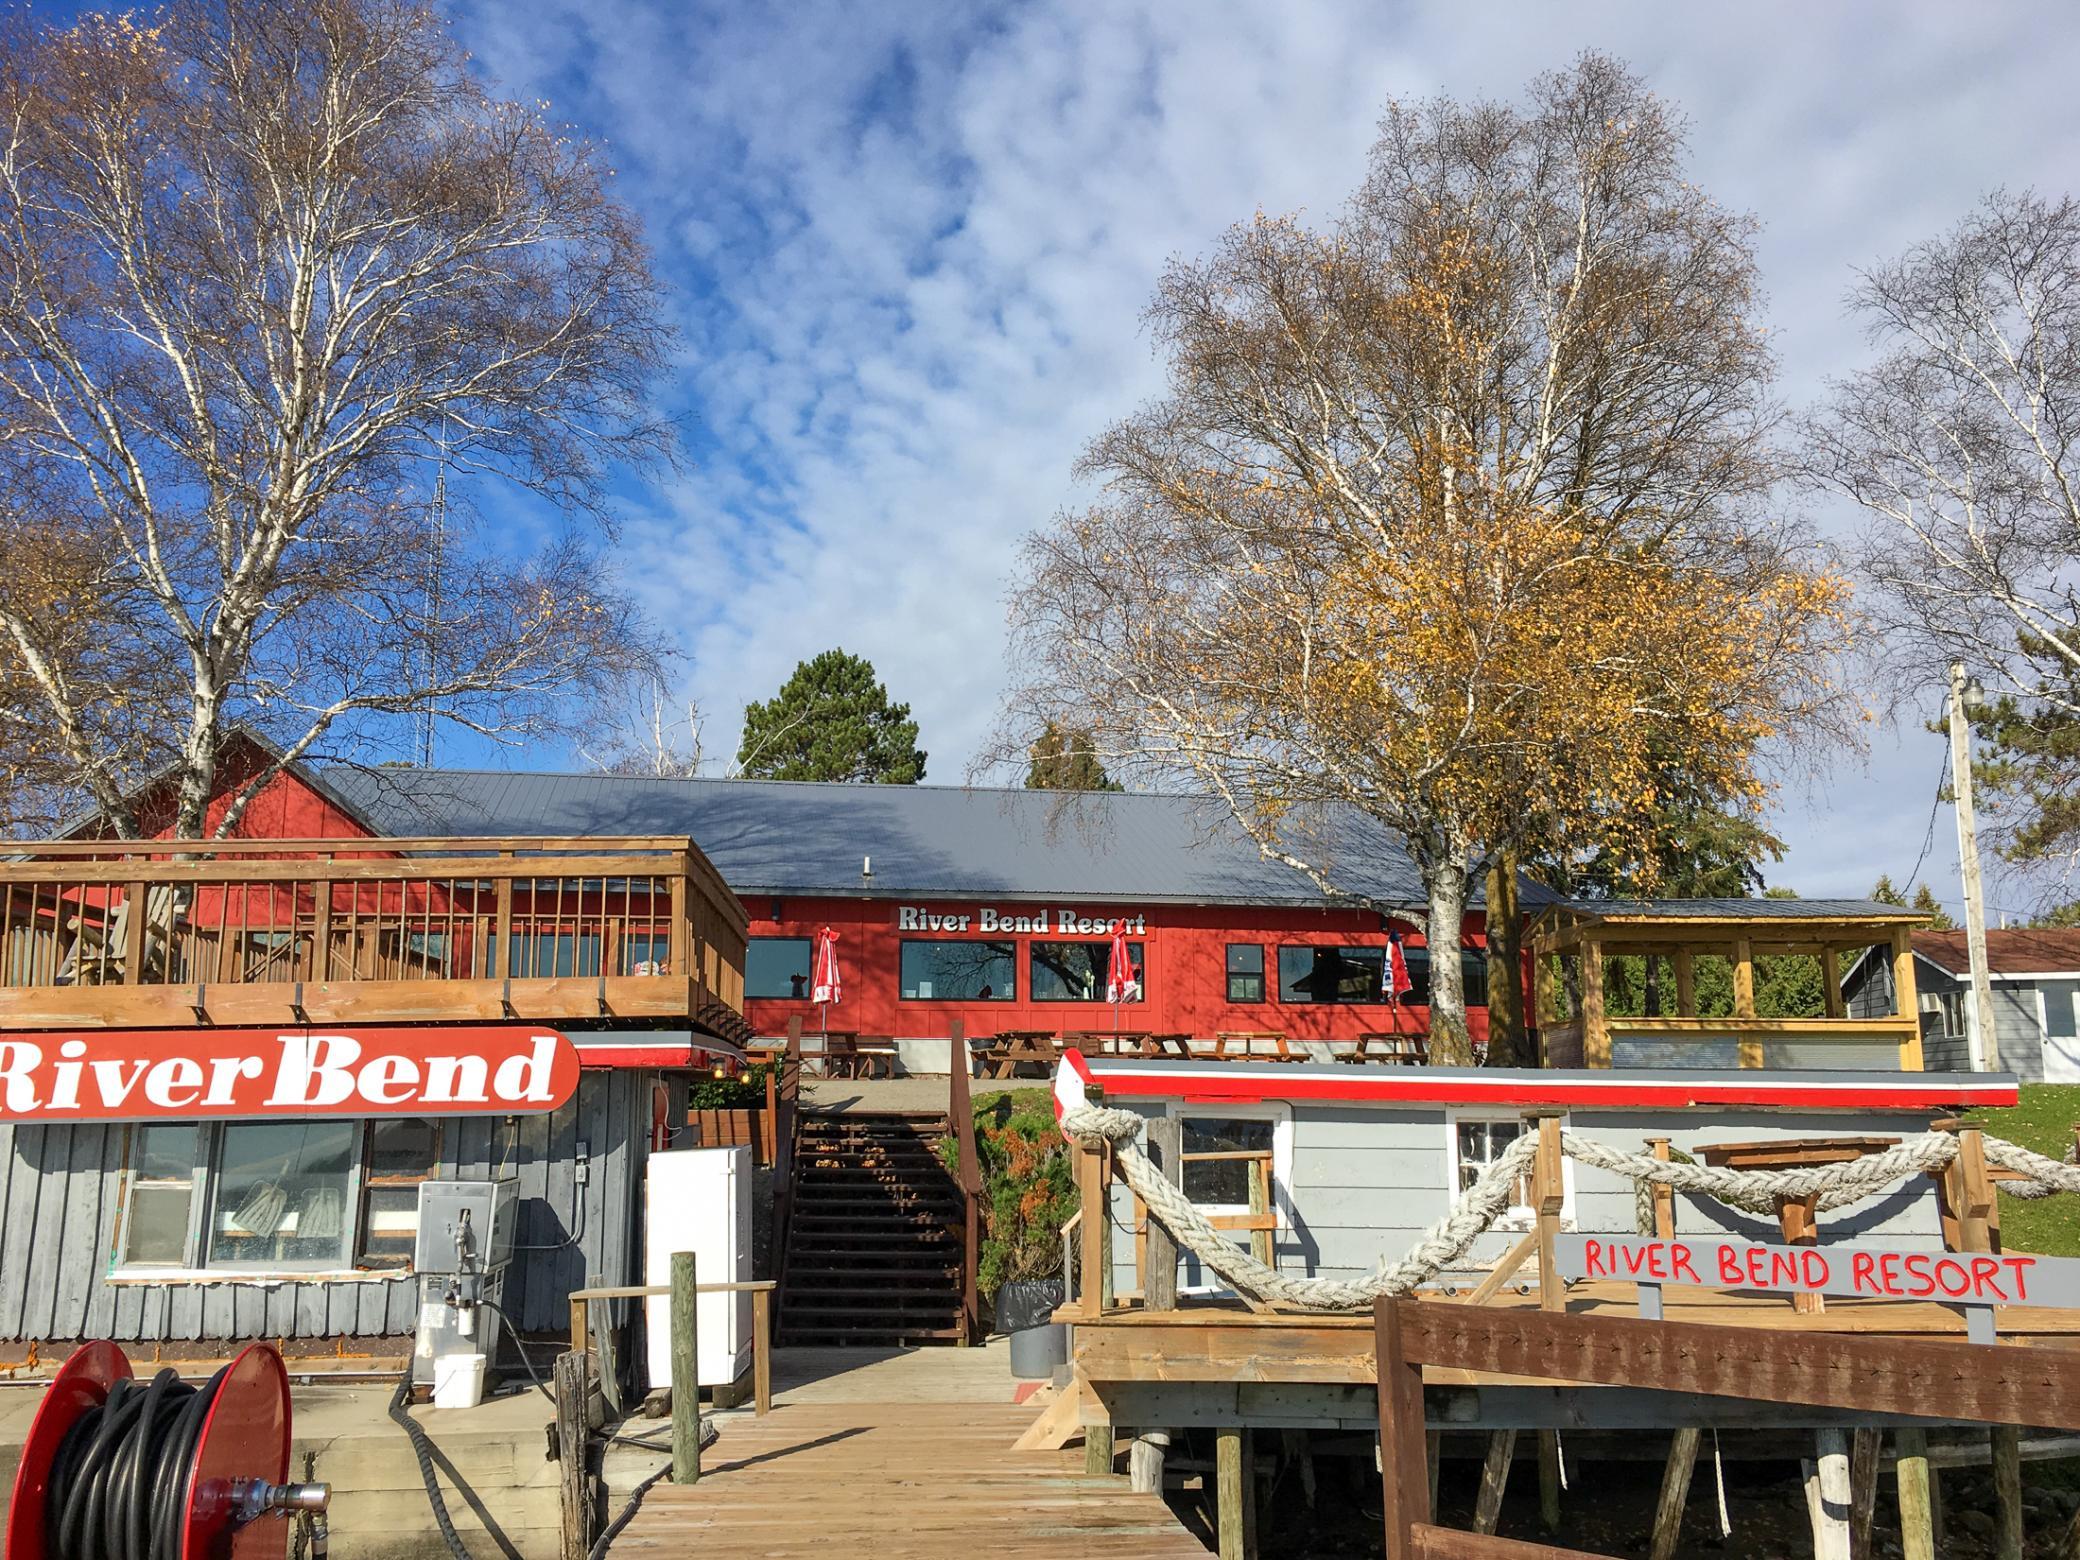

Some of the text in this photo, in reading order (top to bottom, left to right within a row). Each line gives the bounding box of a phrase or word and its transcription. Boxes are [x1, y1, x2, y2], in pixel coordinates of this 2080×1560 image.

[898, 906, 970, 932] River
[979, 908, 1049, 934] Bend
[1585, 1239, 2036, 1300] RIVER BEND RESORT
